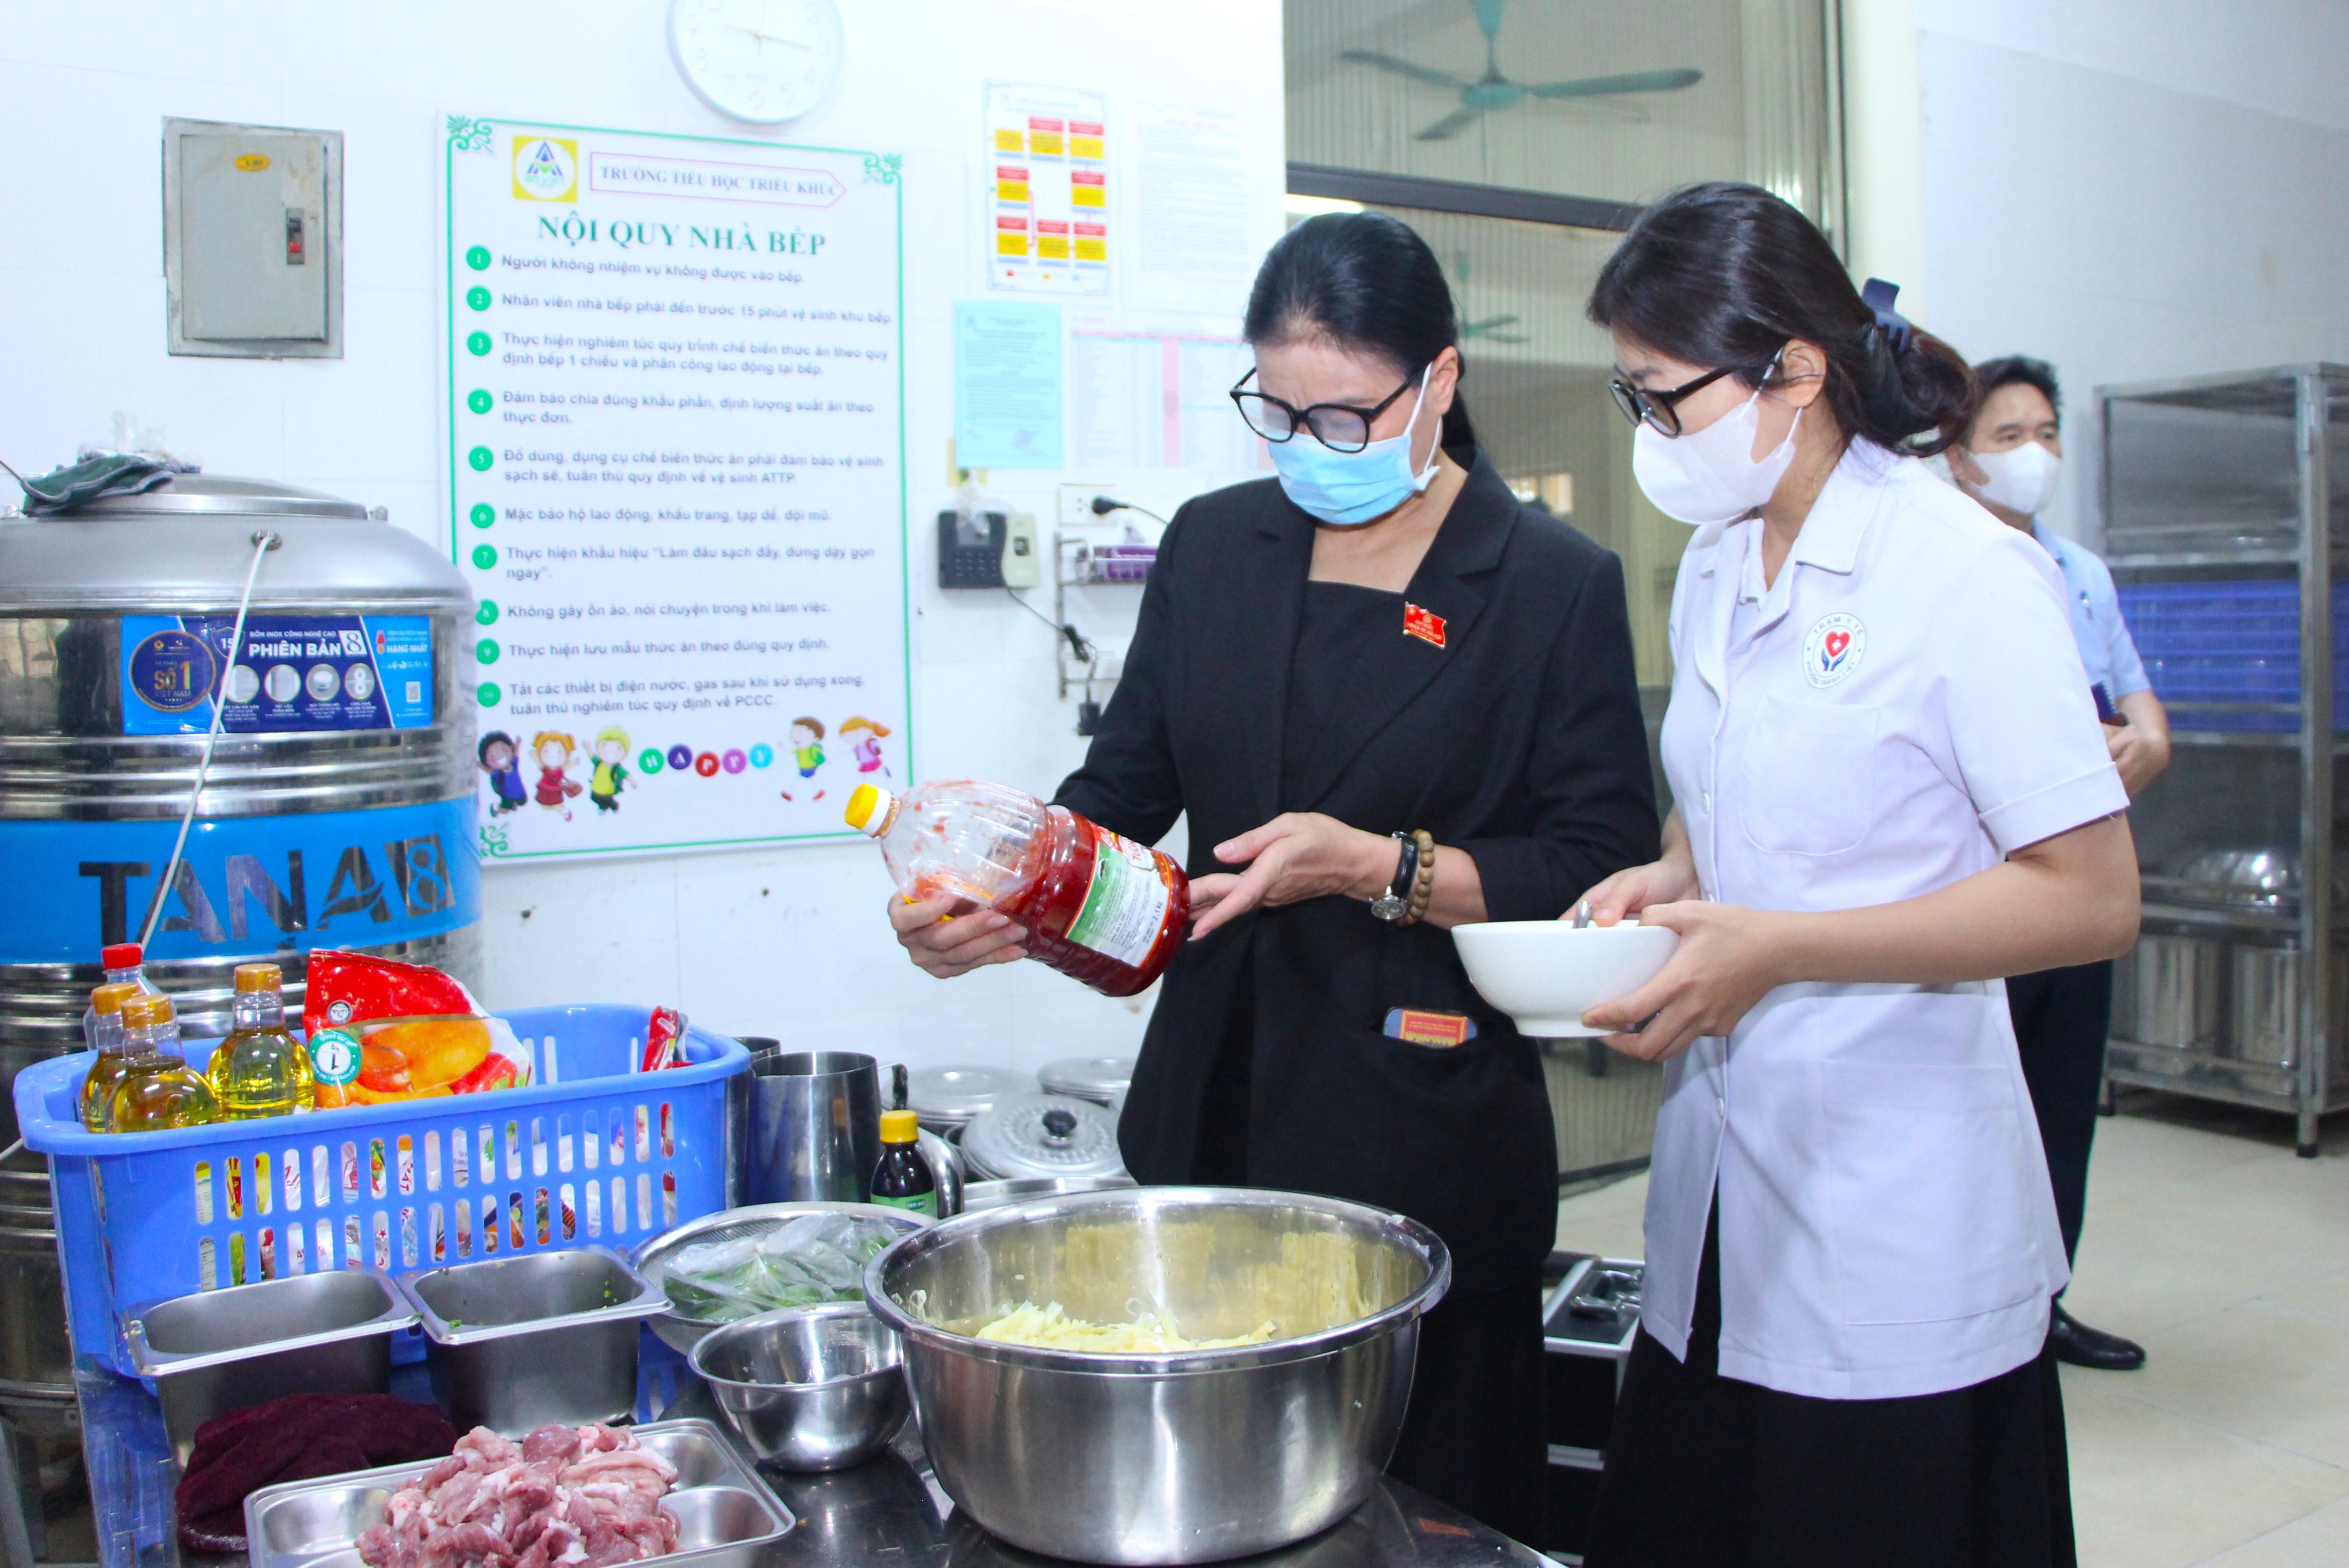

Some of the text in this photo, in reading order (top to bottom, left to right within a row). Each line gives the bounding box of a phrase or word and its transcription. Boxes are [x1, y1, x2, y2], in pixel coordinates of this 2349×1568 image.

[249, 632, 361, 656] PHIÊN BẢN 8
[180, 660, 191, 690] 1
[174, 690, 191, 698] NAM
